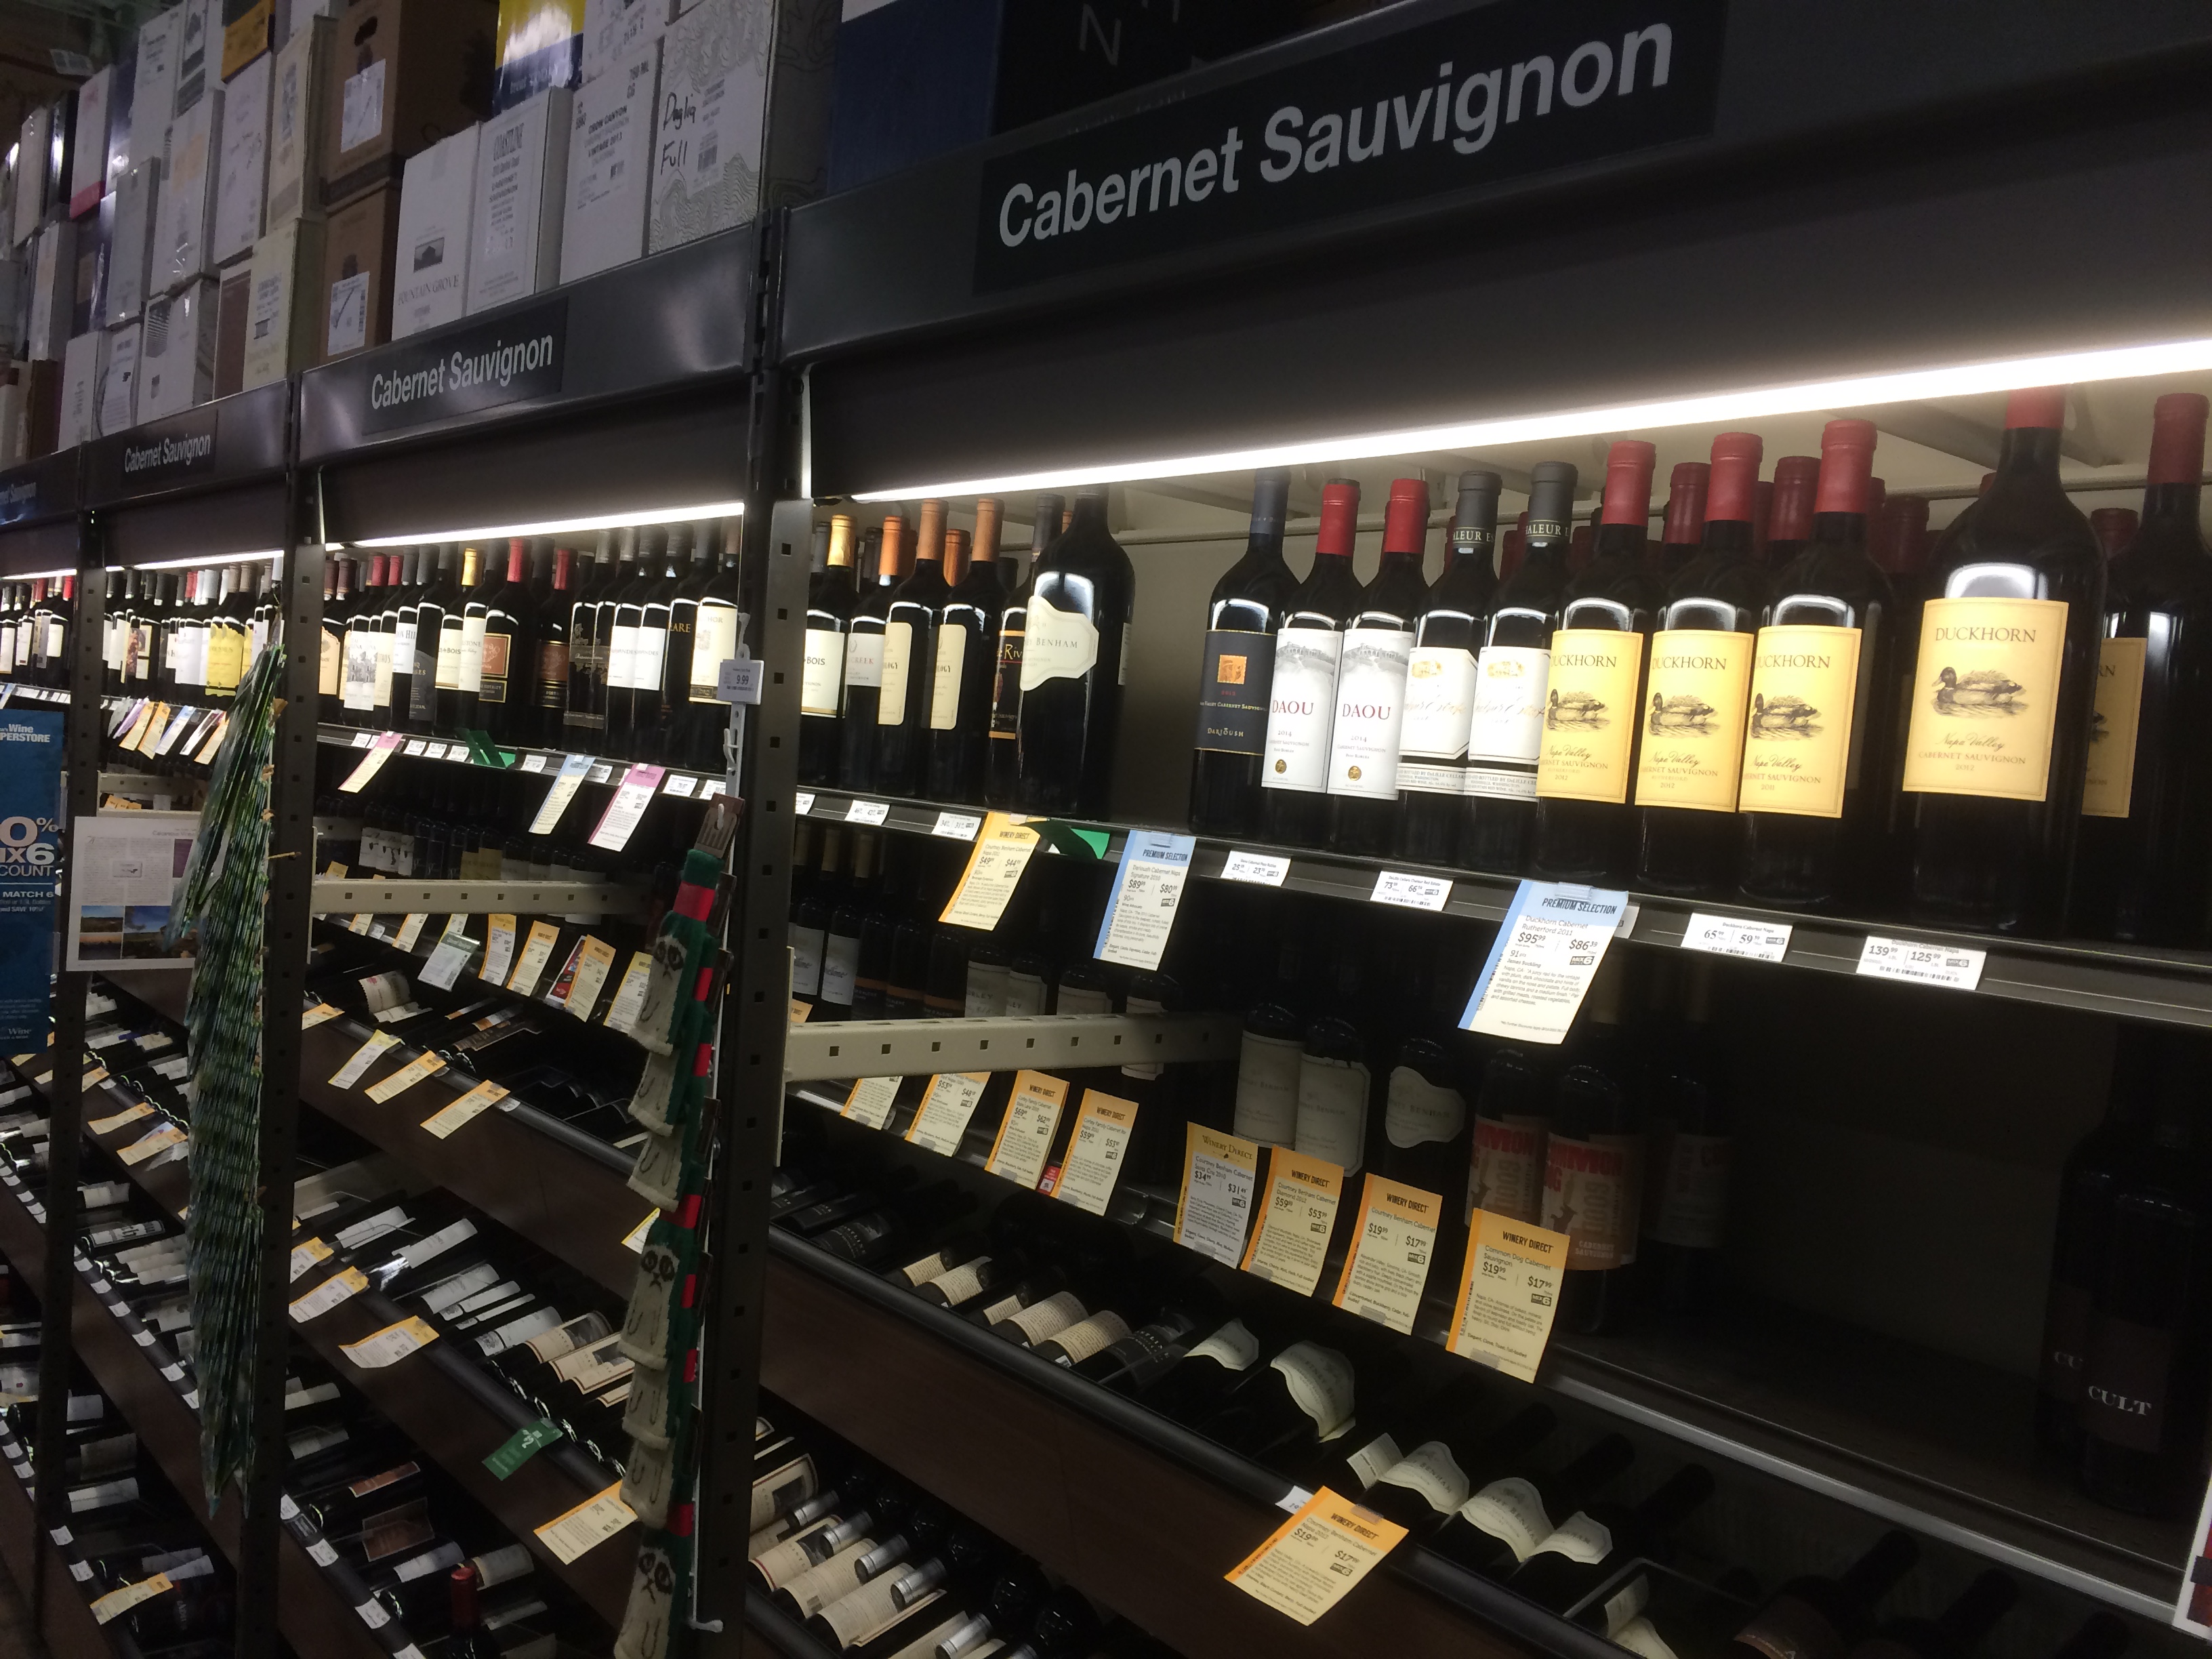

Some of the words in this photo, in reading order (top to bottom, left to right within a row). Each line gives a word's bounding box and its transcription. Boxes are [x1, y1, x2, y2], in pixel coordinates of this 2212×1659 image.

[999, 129, 1242, 247] Cabernet
[1259, 22, 1673, 183] Sauvignon
[660, 139, 689, 176] Full
[371, 363, 445, 411] Cabernet
[449, 333, 554, 389] Sauvignon
[124, 443, 162, 473] Cabernet
[163, 434, 211, 466] Sauvignon
[1036, 637, 1078, 649] BENHAM
[1935, 627, 2036, 643] DUCKHORN
[806, 656, 825, 665] BOIS
[1272, 699, 1314, 716] DAOU
[1342, 703, 1391, 720] DAOU
[8, 724, 34, 733] Wine
[1966, 733, 2005, 752] Valley
[1562, 744, 1592, 762] Valley
[1669, 750, 1700, 768] Valley
[1919, 751, 1961, 760] CABERNET
[1965, 753, 2026, 764] SAUVIGNON
[1561, 760, 1609, 770] SAUVIGNON
[1769, 754, 1802, 771] Valley
[1666, 767, 1719, 777] SAUVIGNON
[1766, 773, 1822, 784] SAUVIGNON
[999, 830, 1016, 839] WINERY
[1142, 848, 1166, 860] PREMIUM
[1165, 851, 1188, 861] SELECTION
[2, 891, 44, 899] MATCH
[1541, 897, 1578, 910] PREMIUM
[1578, 901, 1618, 915] SELECTION
[1521, 923, 1557, 934] Rutherford
[1525, 914, 1557, 926] Duckhorn
[1558, 919, 1589, 929] Cabernet
[1202, 1134, 1227, 1151] WINERY
[1228, 1144, 1253, 1160] DIRECT
[1291, 1168, 1311, 1183] WINERY
[1311, 1175, 1330, 1189] DIRECT
[1387, 1193, 1408, 1208] WINERY
[1408, 1198, 1429, 1214] DIRECT
[1371, 1206, 1393, 1221] Courtney
[1393, 1213, 1413, 1227] Benham
[1414, 1220, 1436, 1233] Cabernet
[1502, 1231, 1528, 1246] WINERY
[1528, 1238, 1554, 1254] DIRECT
[1483, 1253, 1513, 1269] Sauvignon
[1485, 1245, 1511, 1258] Common
[1511, 1253, 1524, 1264] Dog
[1524, 1256, 1551, 1271] Cabernet
[2087, 1385, 2152, 1416] CULT
[1330, 1512, 1356, 1532] WINERY
[1353, 1524, 1379, 1540] DIRECT
